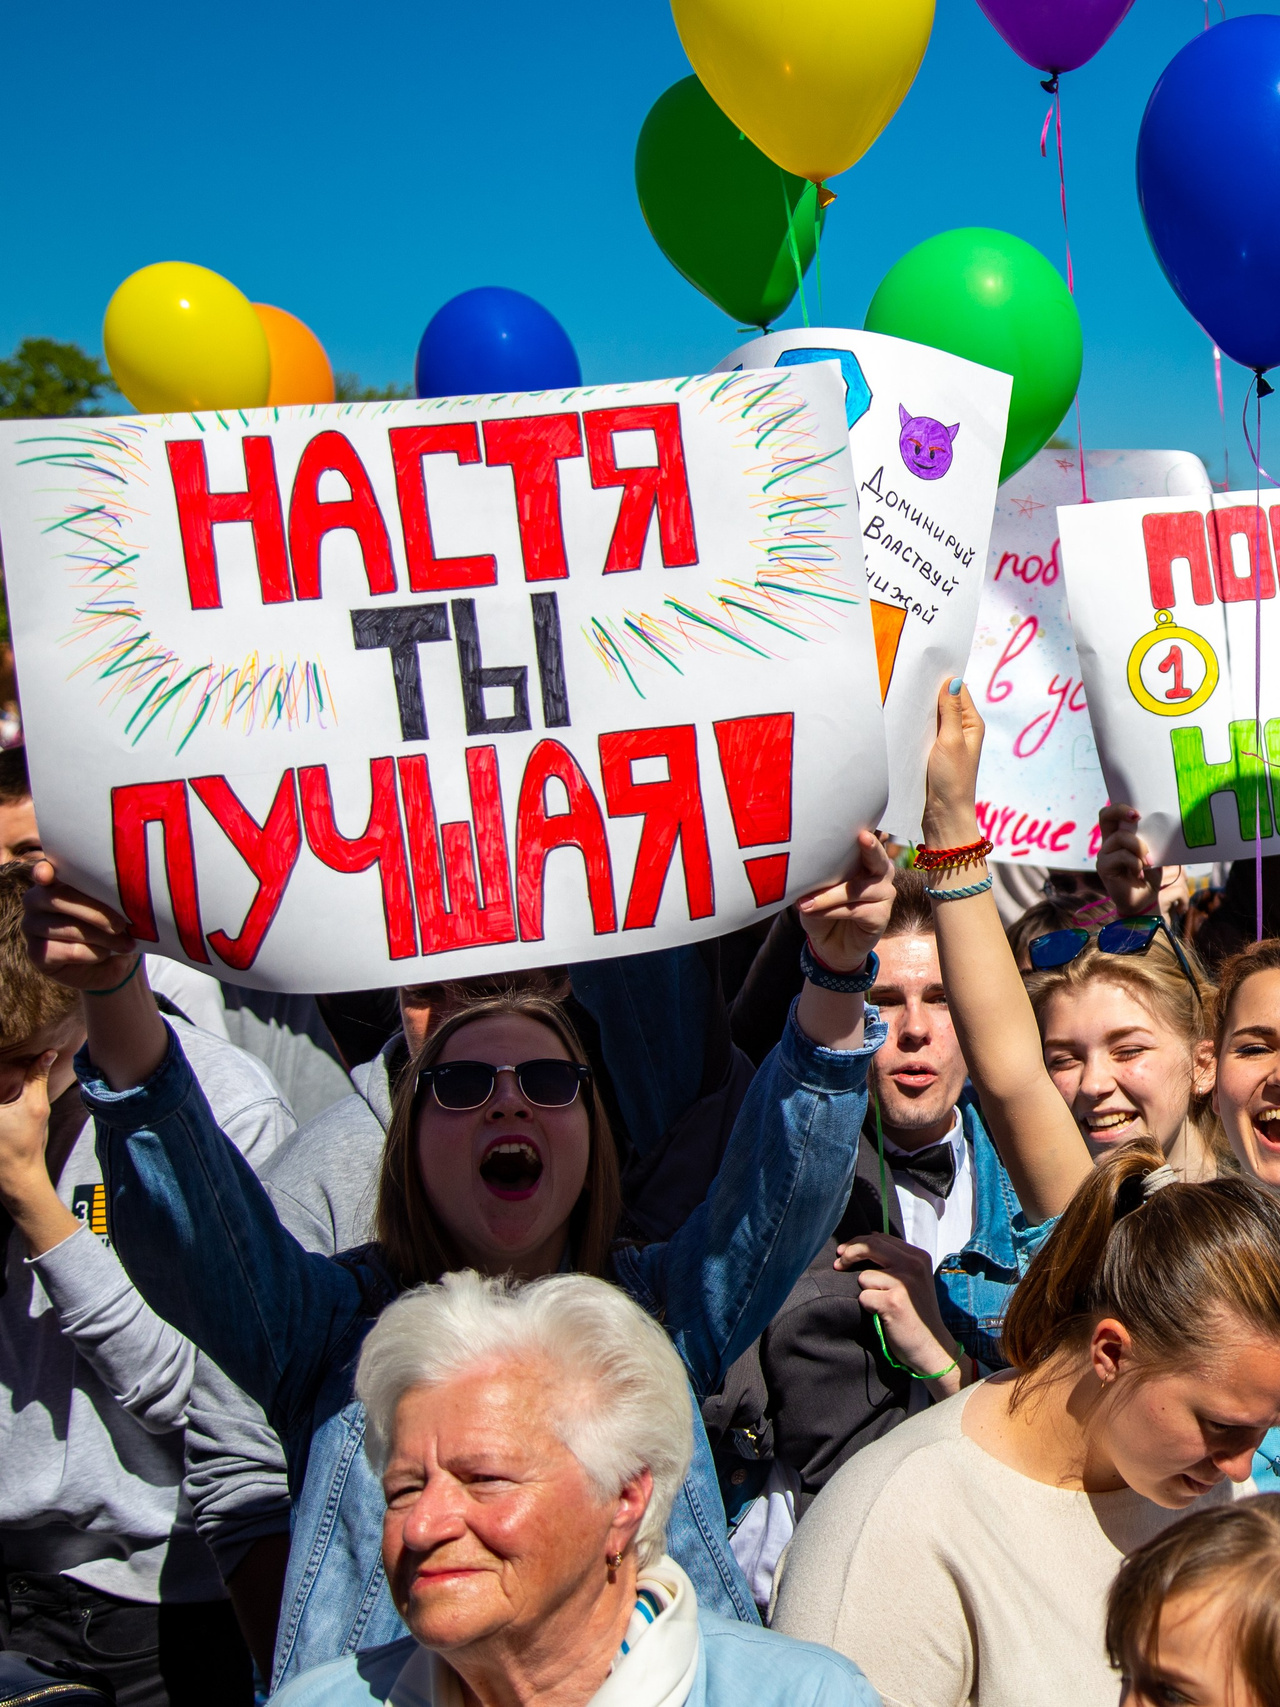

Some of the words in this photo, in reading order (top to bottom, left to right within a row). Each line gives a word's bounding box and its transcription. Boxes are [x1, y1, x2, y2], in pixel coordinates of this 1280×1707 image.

[165, 403, 698, 610] НАСТЯ
[864, 554, 939, 625] нижай
[350, 592, 571, 741] ТЫ
[1158, 645, 1192, 699] 1
